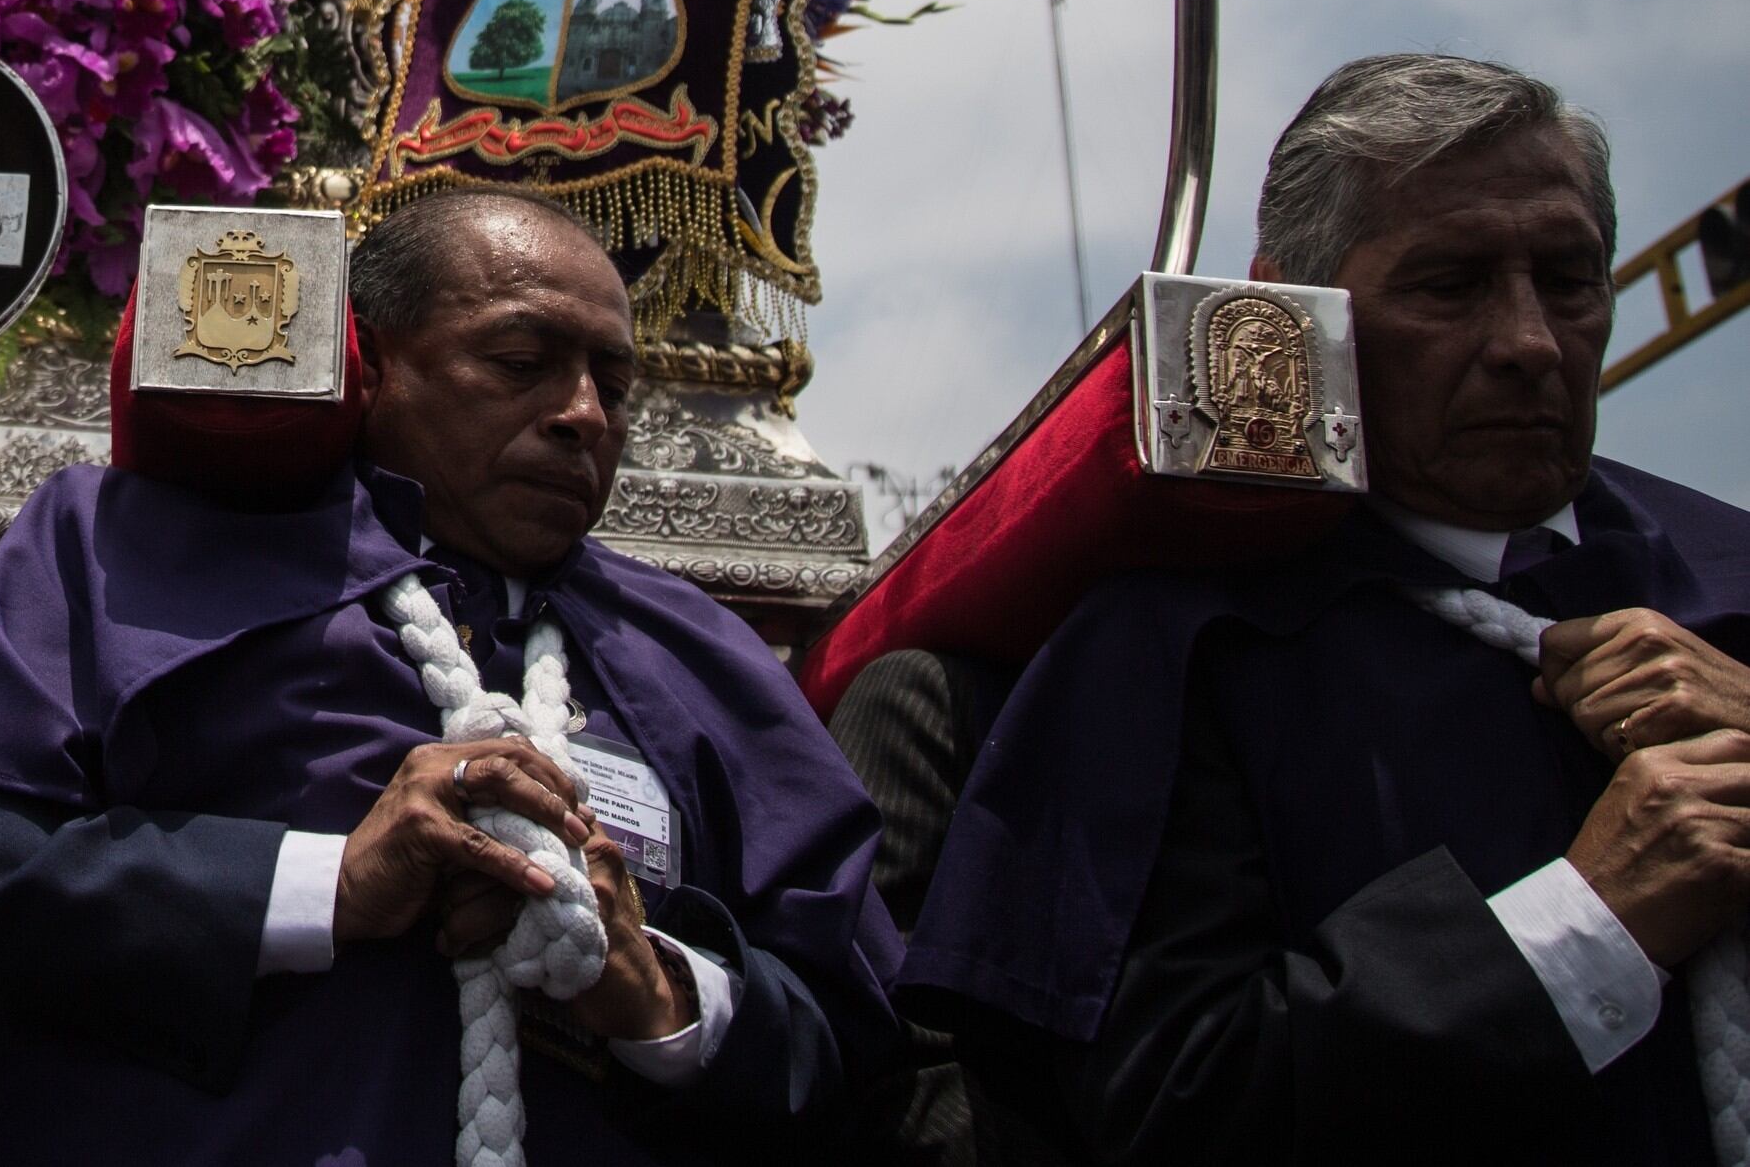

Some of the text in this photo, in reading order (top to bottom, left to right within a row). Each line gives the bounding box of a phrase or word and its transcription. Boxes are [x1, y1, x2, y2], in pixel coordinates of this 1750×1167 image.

[1251, 424, 1272, 445] 16
[1217, 450, 1310, 474] EMERGENCIA
[611, 801, 634, 812] PANTA
[611, 814, 640, 827] MARCOS
